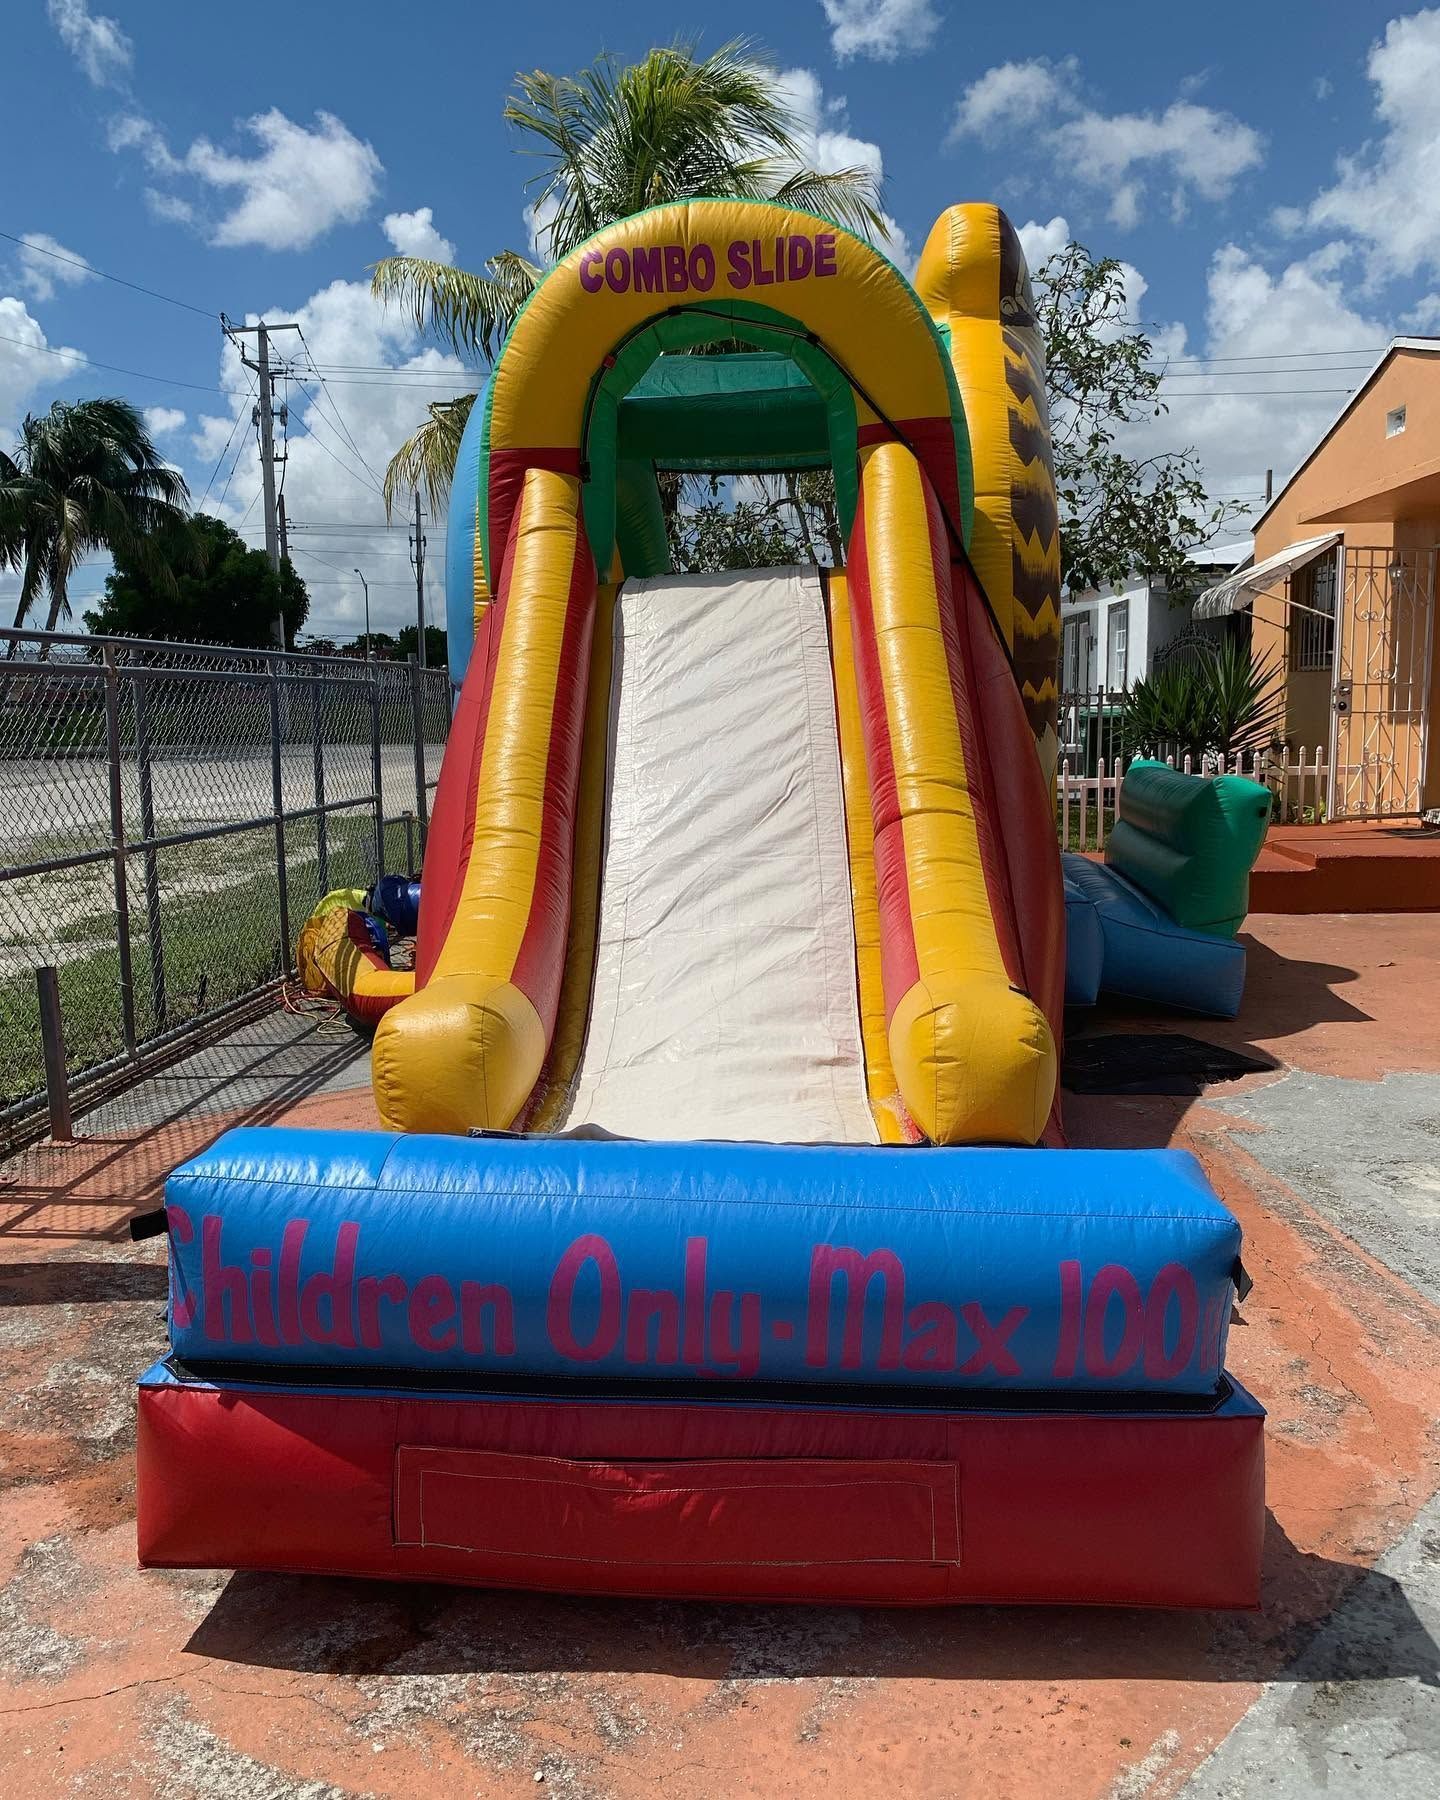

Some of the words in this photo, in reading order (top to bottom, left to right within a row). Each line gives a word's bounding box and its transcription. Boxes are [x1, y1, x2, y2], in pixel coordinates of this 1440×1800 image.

[579, 243, 716, 293] COMBO
[727, 234, 838, 289] SLIDE
[1051, 1259, 1200, 1380] 100
